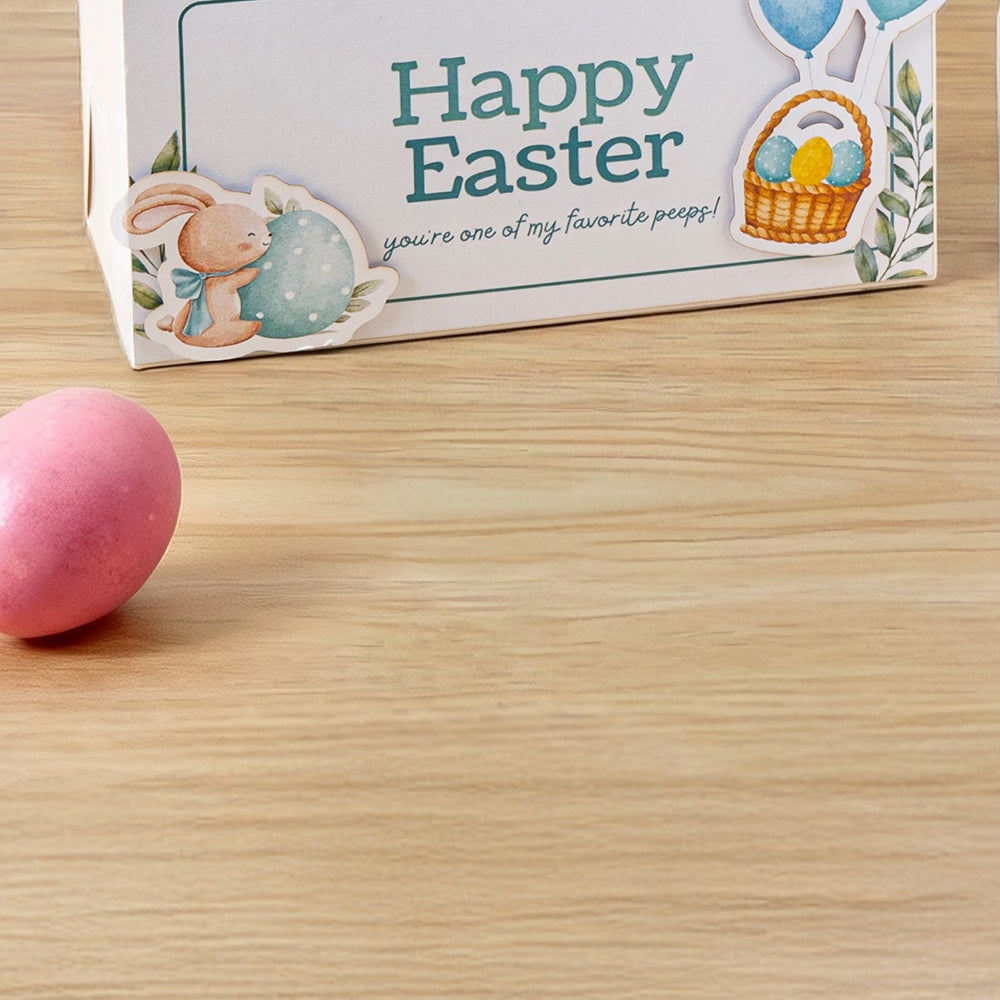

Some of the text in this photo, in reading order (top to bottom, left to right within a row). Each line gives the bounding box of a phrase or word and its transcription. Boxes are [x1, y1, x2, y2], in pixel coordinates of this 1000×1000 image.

[391, 53, 693, 131] Happy
[405, 126, 684, 203] Easter
[383, 196, 721, 261] you're one of my favorite peeps!
